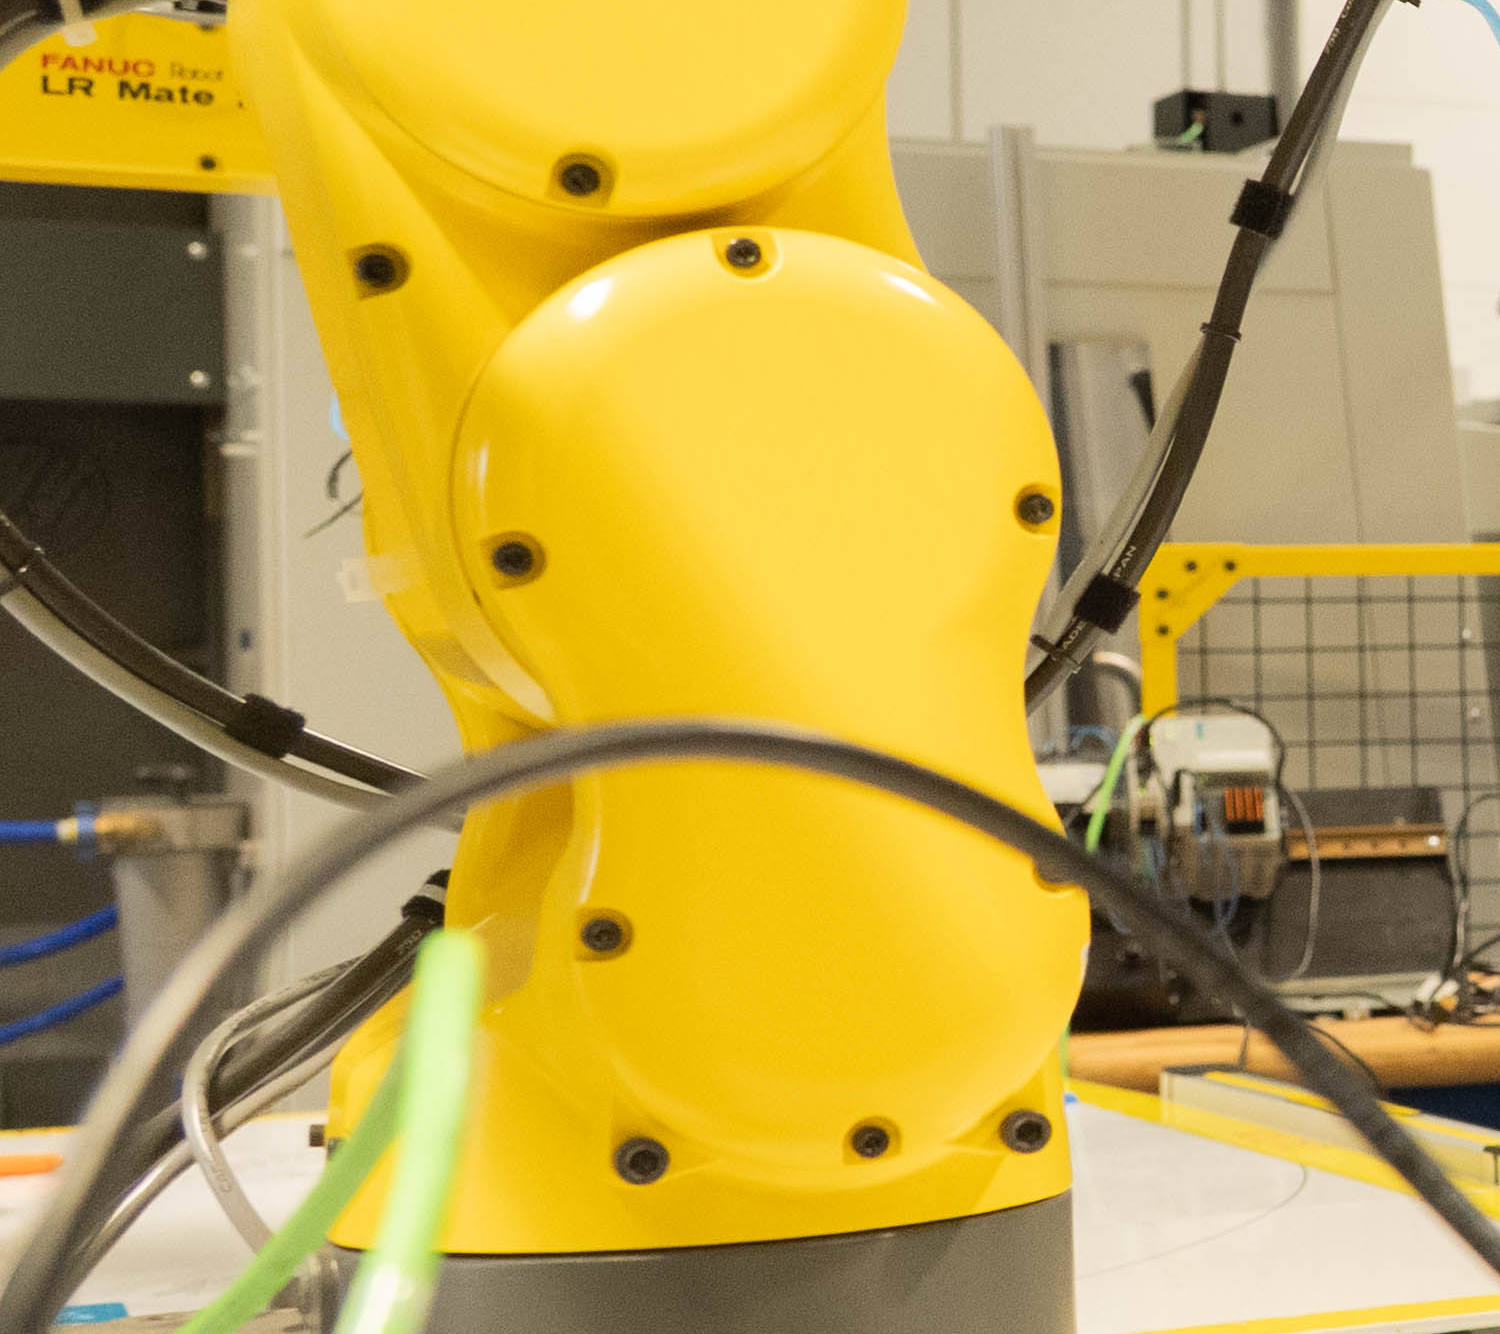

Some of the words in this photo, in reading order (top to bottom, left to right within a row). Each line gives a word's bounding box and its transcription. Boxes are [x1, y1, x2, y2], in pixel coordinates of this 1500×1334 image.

[40, 53, 156, 77] FANUC
[40, 75, 94, 97] LR
[118, 80, 215, 107] Mate
